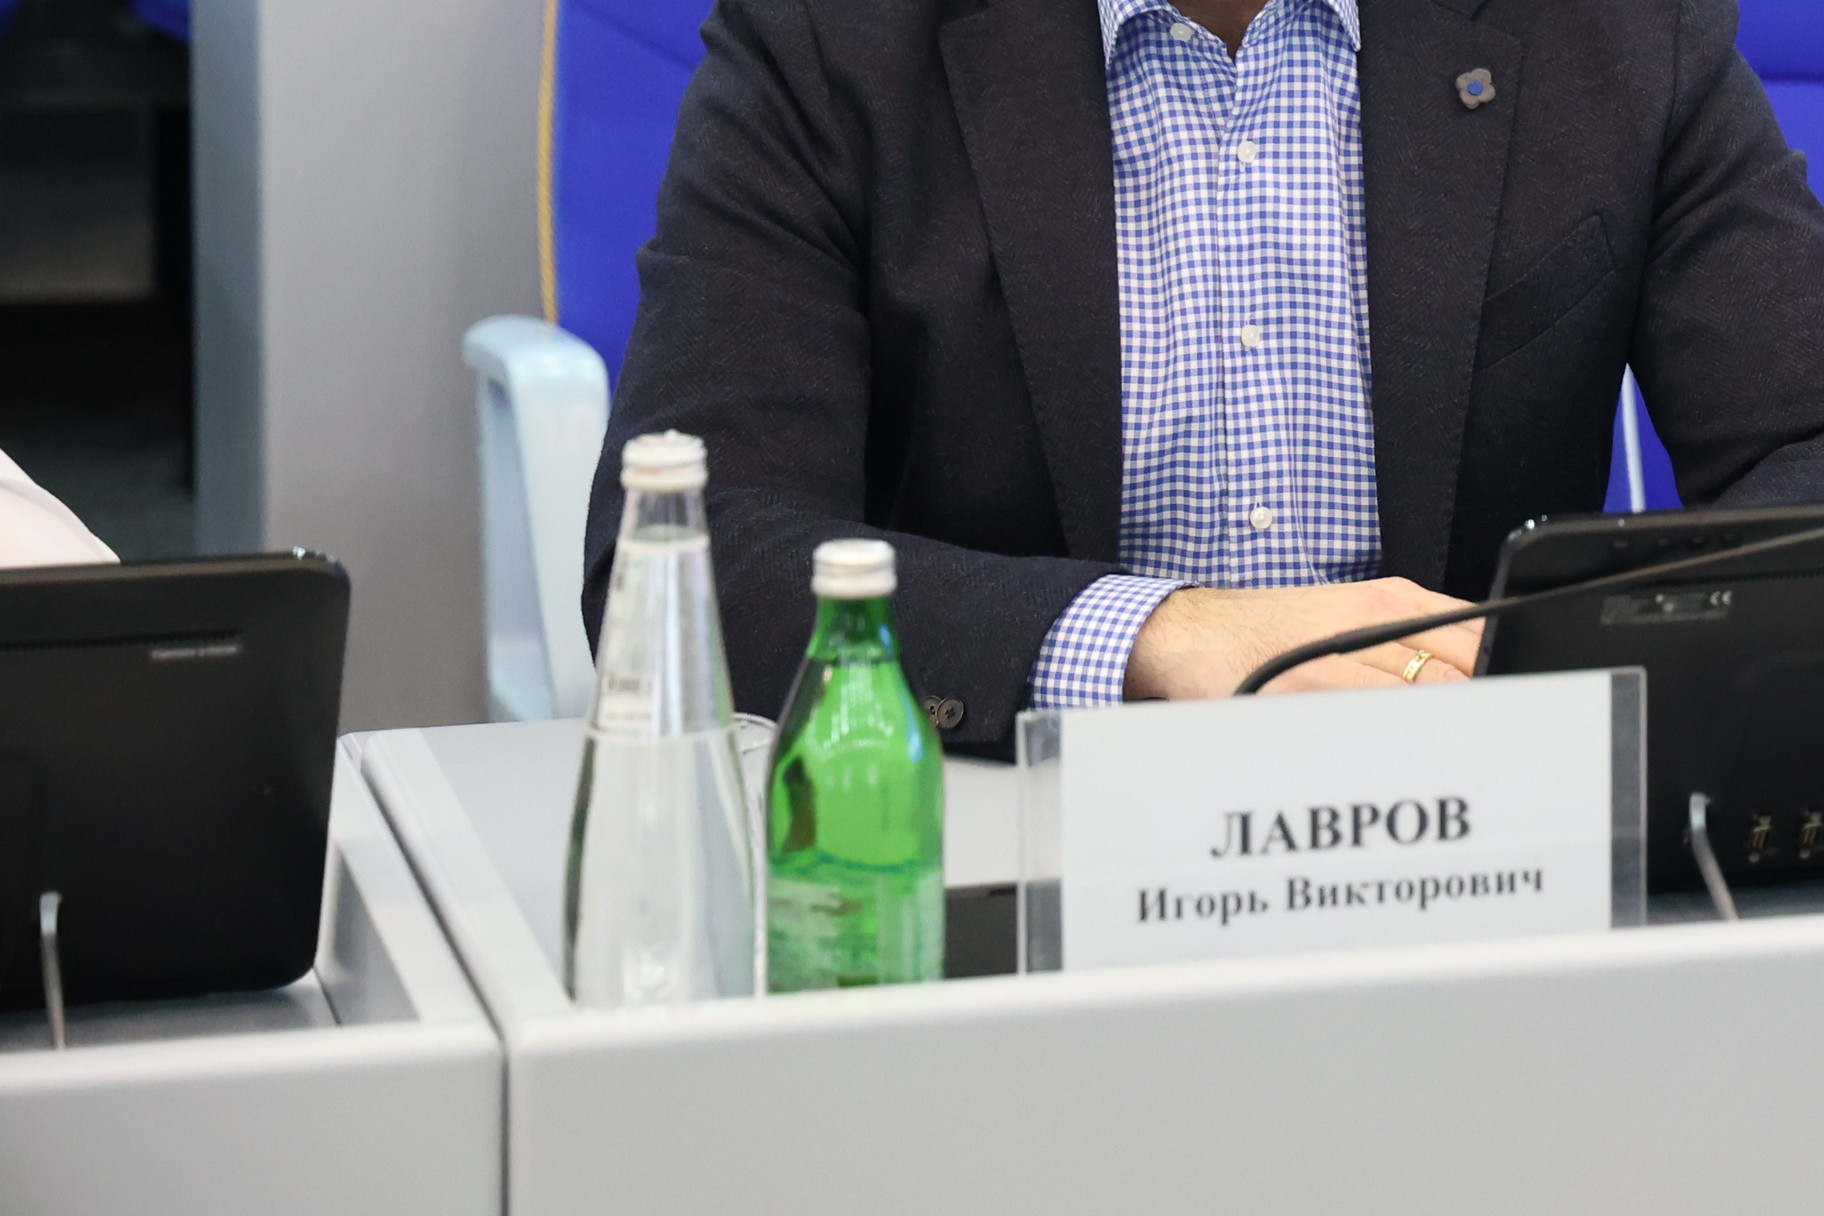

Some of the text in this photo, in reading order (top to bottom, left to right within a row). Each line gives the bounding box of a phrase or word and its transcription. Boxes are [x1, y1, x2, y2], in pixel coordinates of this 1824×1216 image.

[1209, 796, 1472, 859] ЛАВРОВ
[1137, 869, 1543, 926] Игорь Викторович
